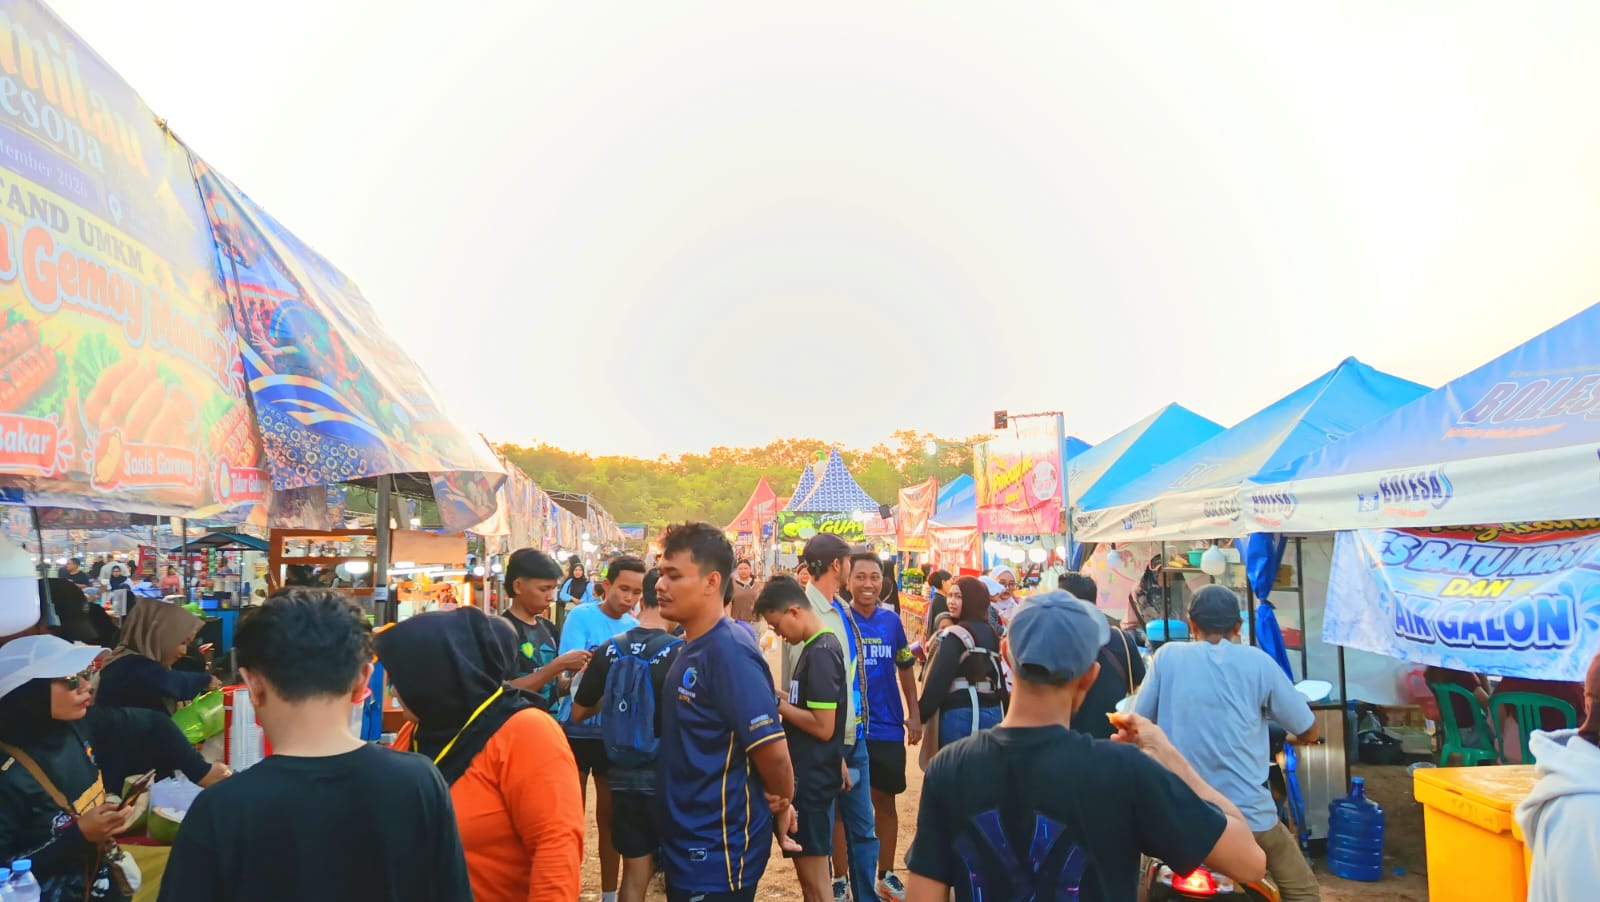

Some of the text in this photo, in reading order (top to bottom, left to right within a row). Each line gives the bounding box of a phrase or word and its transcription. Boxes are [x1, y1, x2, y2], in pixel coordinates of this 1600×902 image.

[76, 215, 145, 275] UMKM
[19, 217, 147, 348] Gemoy
[124, 450, 154, 476] Sosis
[1404, 539, 1514, 578] BATU
[1440, 577, 1512, 599] DAN
[1393, 590, 1576, 649] AIR GALON
[871, 645, 892, 659] RUN
